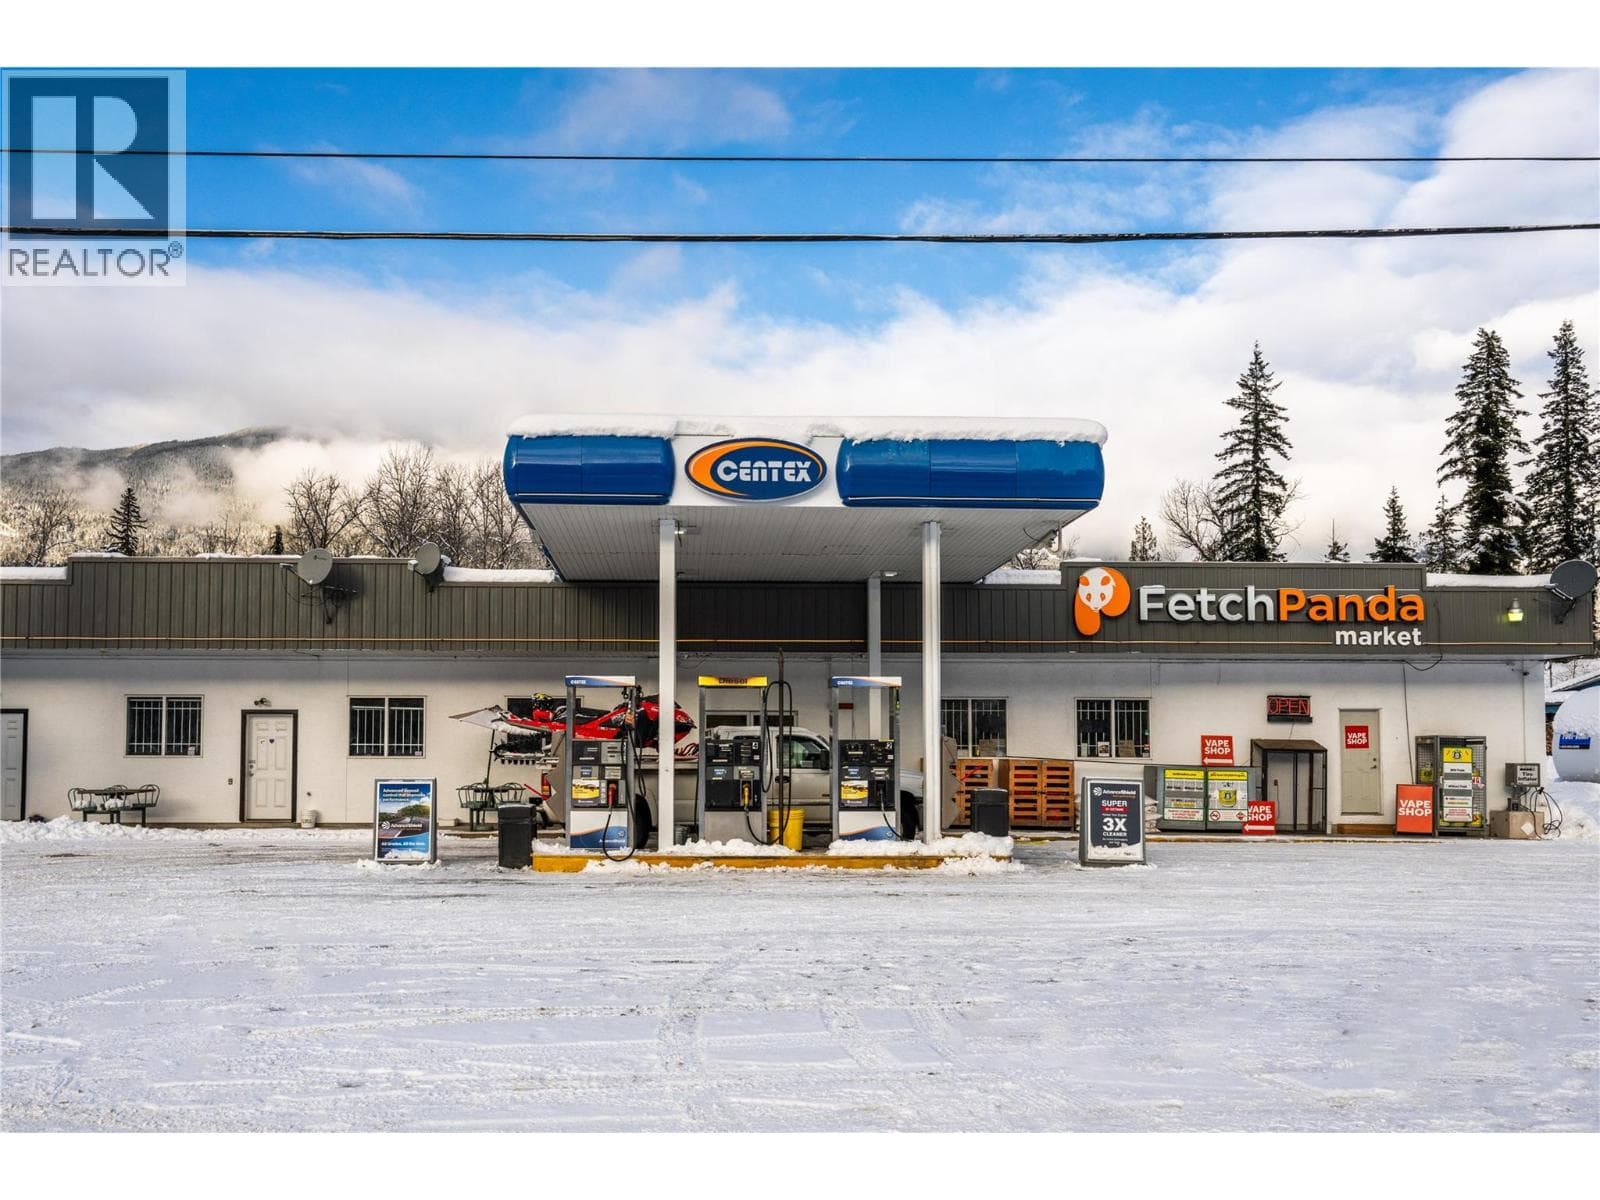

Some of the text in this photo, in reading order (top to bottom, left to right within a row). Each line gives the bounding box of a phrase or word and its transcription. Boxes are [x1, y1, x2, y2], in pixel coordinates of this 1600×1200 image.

[717, 459, 812, 482] CENTEX
[1139, 585, 1425, 622] FetchPanda
[1335, 626, 1422, 646] market
[1268, 699, 1309, 714] OPEN
[1347, 732, 1367, 741] VAPE
[1205, 739, 1230, 748] VAPE
[1204, 746, 1231, 755] SHOP
[1399, 799, 1432, 809] VAPE
[1398, 807, 1432, 817] SHOP
[1102, 817, 1128, 832] 3X
